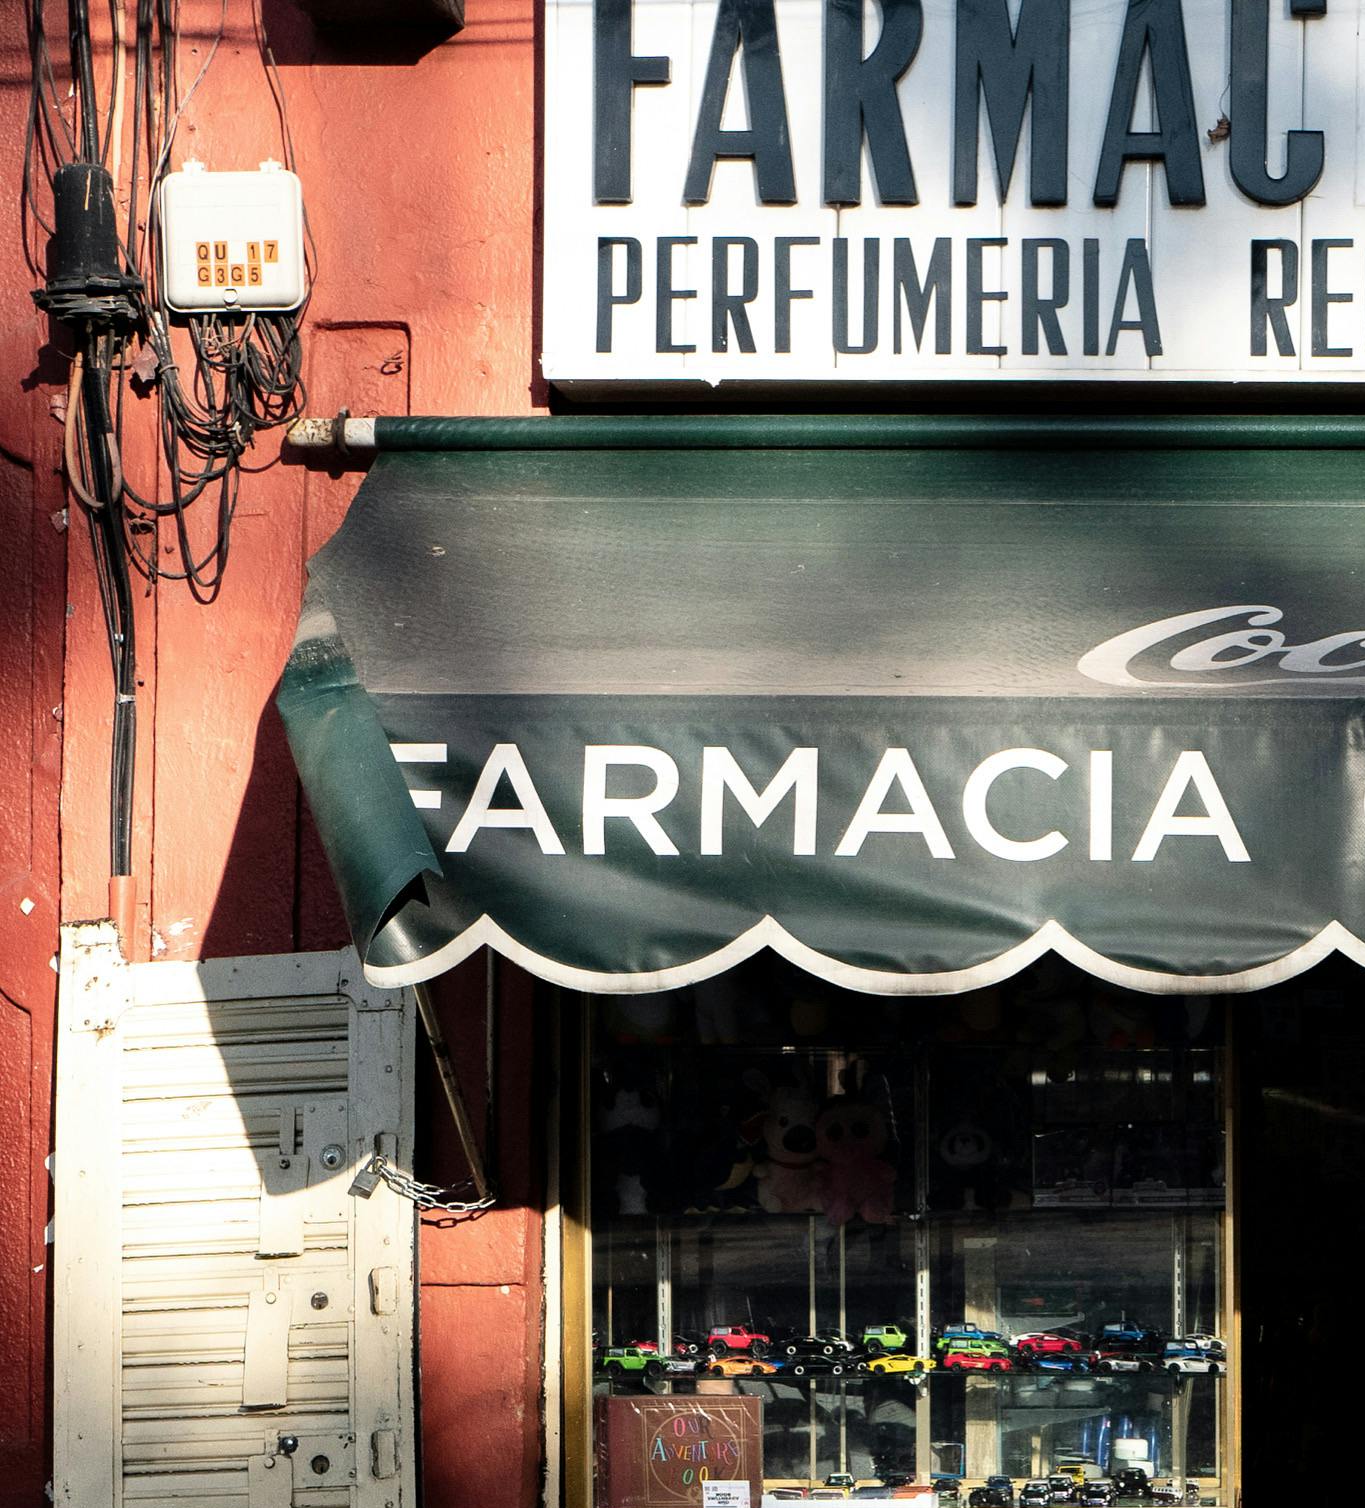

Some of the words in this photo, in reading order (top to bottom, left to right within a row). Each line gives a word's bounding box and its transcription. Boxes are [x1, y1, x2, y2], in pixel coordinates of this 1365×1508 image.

[197, 244, 226, 261] QU
[249, 244, 275, 260] 17
[595, 236, 1164, 357] PERFUMERIA
